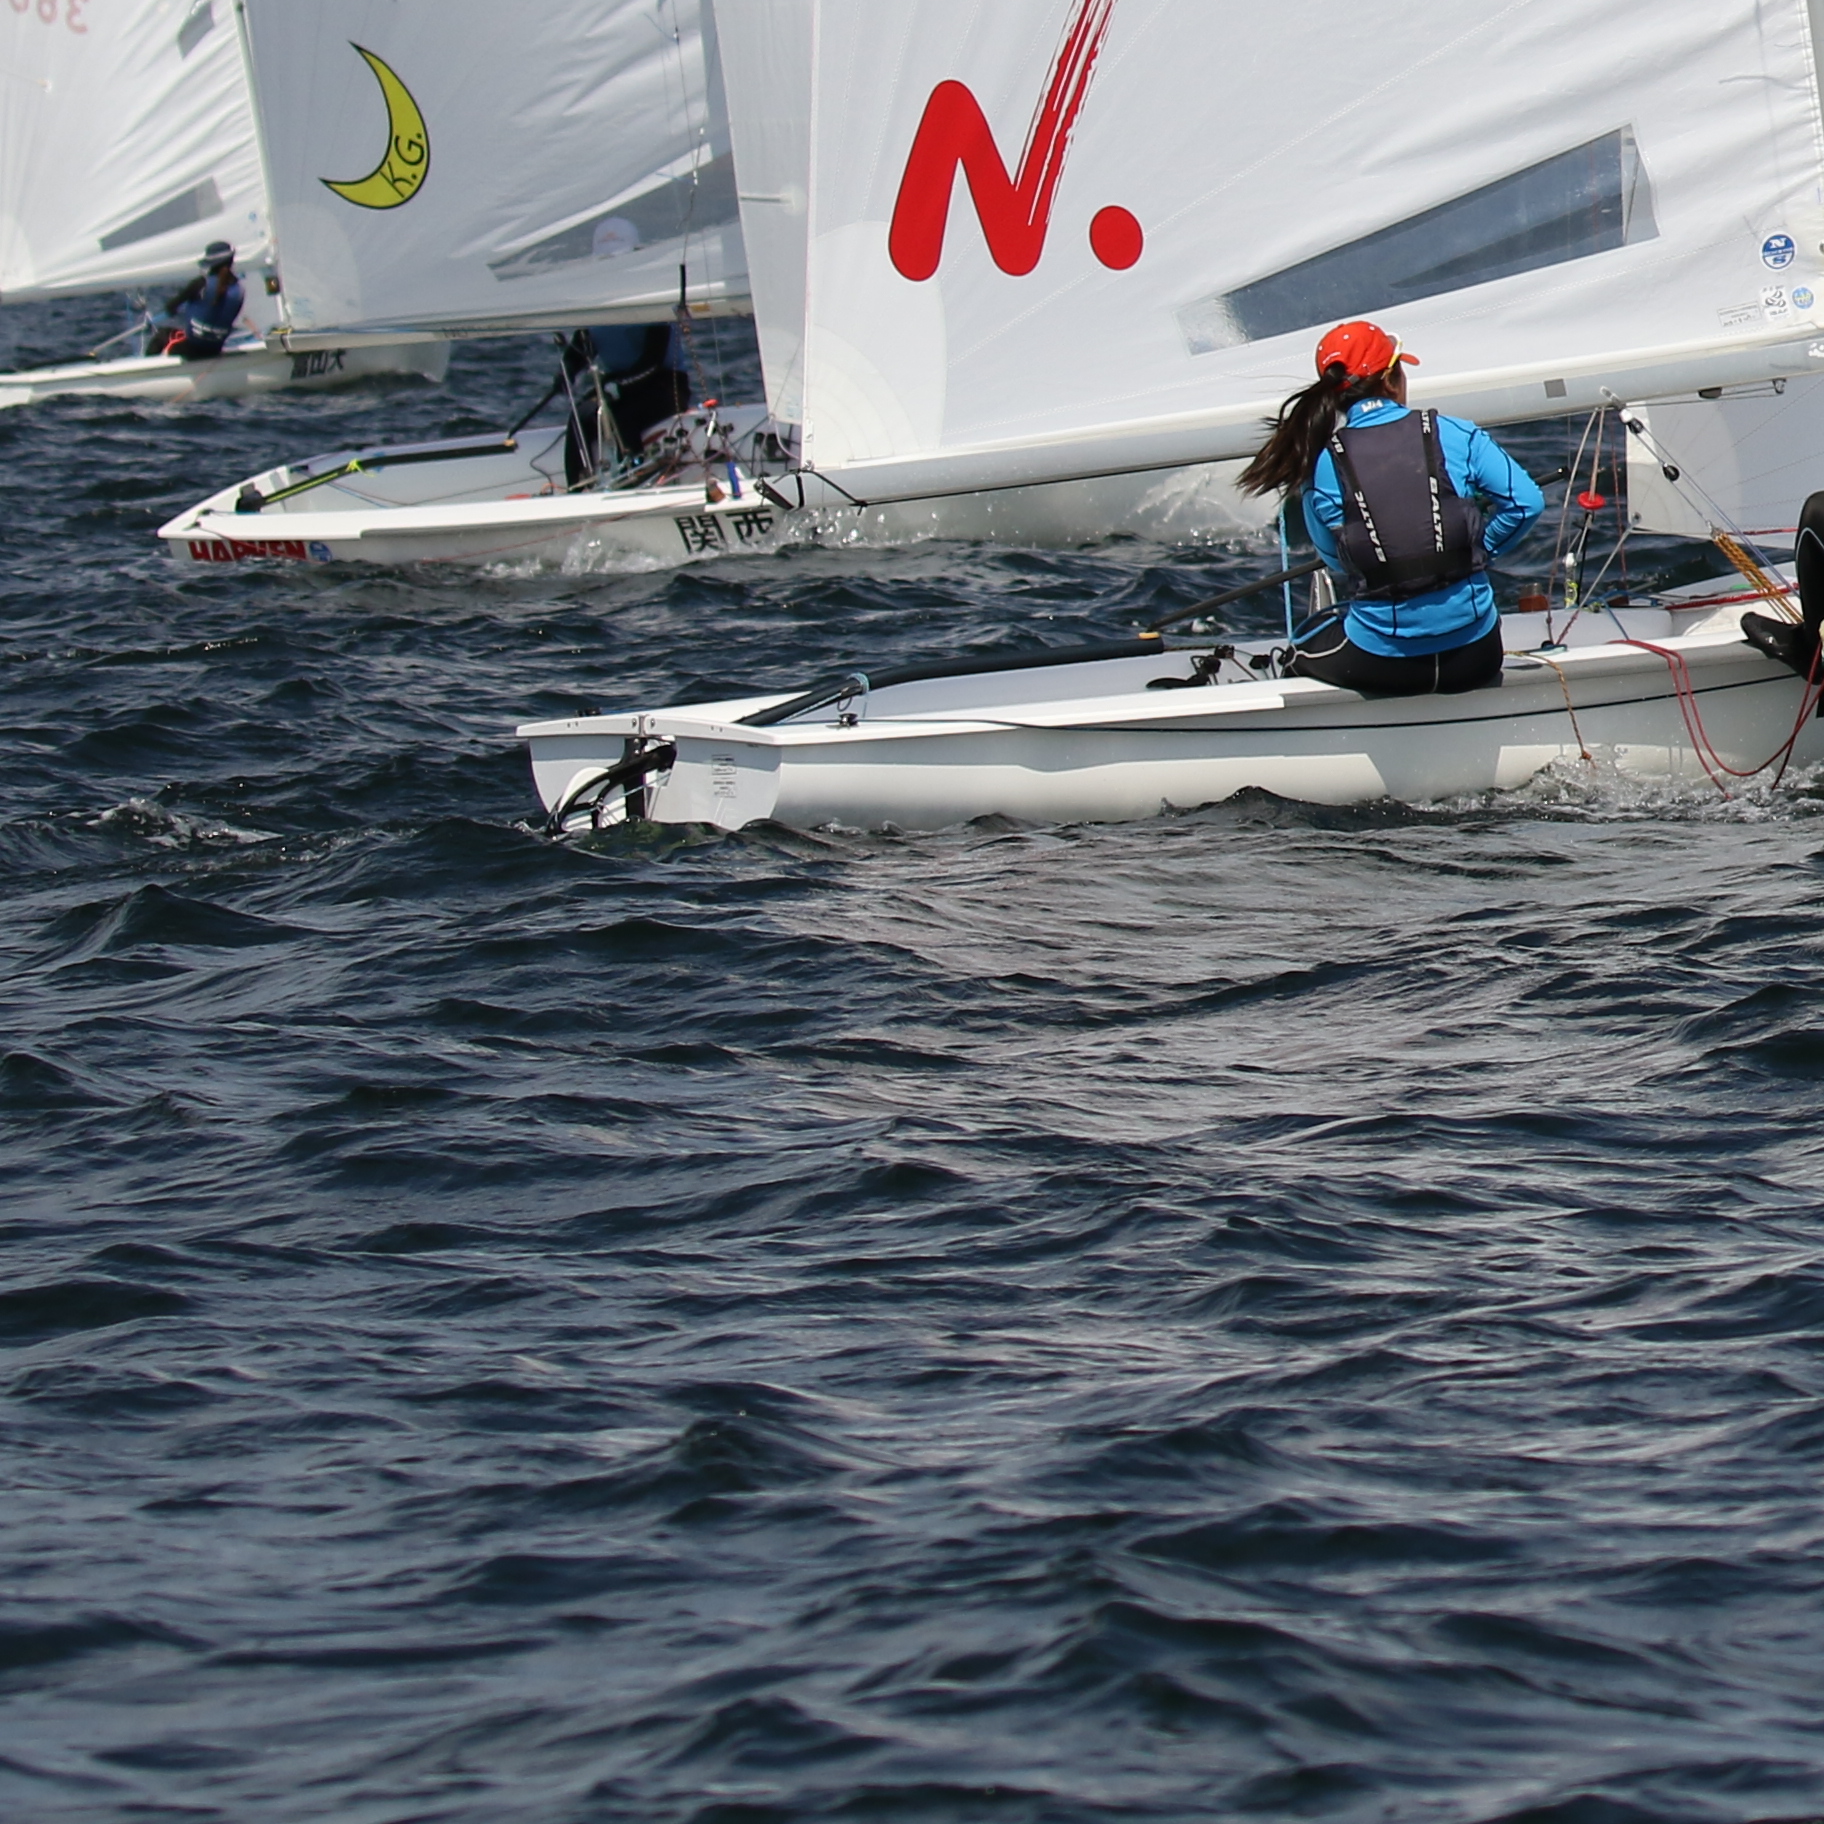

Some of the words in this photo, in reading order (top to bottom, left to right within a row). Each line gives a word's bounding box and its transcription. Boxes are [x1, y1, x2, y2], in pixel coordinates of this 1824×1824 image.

[379, 133, 425, 198] K.G.
[1355, 491, 1387, 563] BALTIC
[1429, 477, 1444, 553] BALTIC
